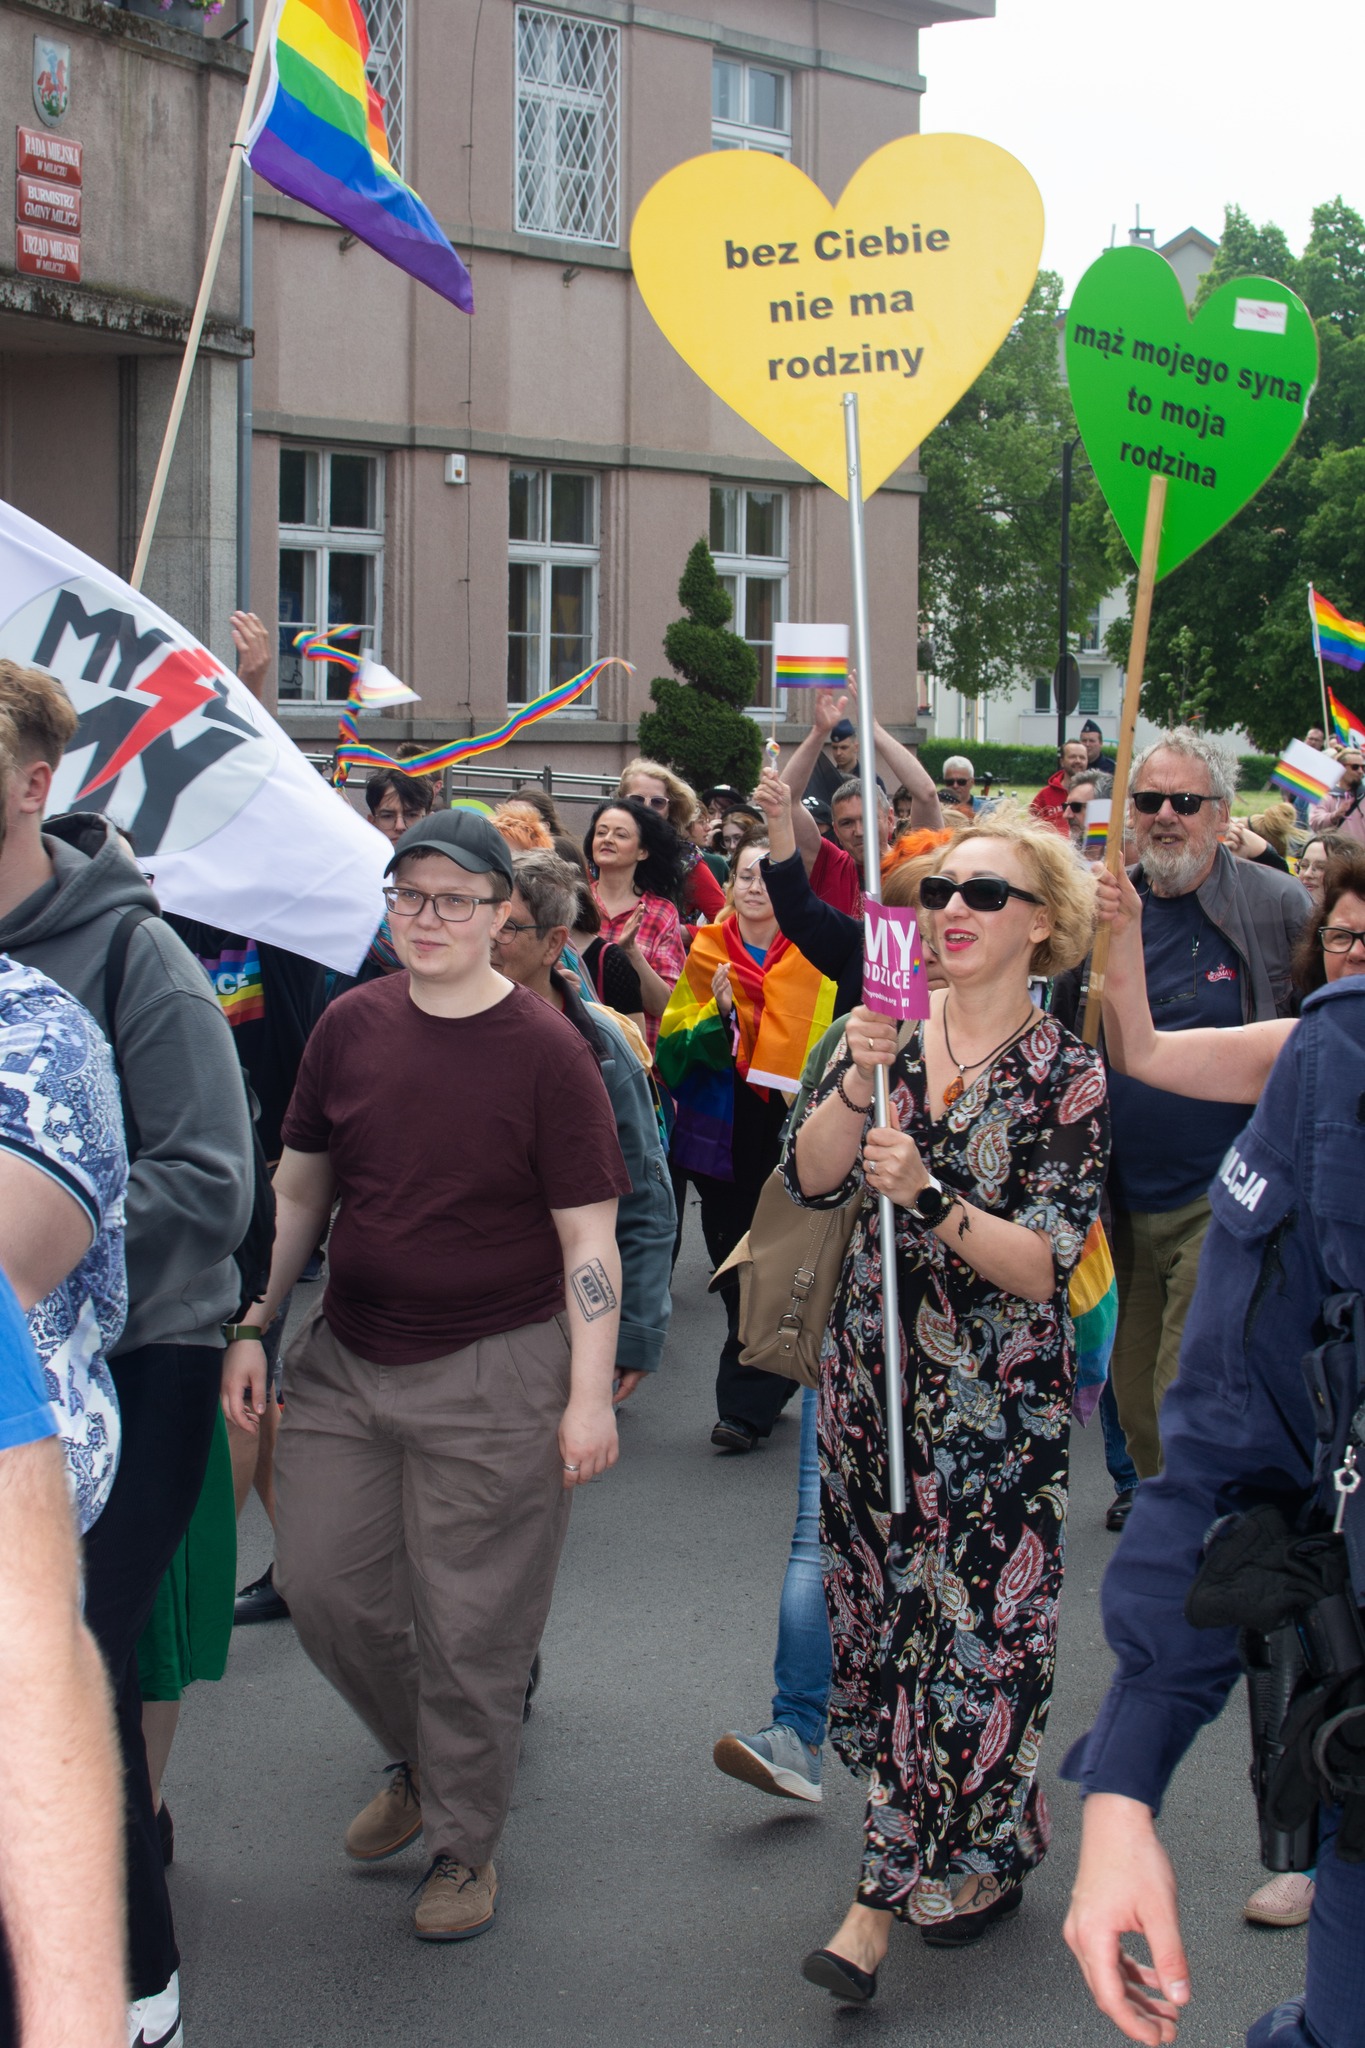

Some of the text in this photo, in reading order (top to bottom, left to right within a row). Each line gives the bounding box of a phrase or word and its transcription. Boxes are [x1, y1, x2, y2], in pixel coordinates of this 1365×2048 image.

[24, 134, 80, 167] RADA MIEJSKA
[37, 160, 68, 177] W MILICZU
[27, 185, 75, 209] BURMISTRZ
[24, 201, 79, 227] GMINY MILICZ
[22, 234, 79, 264] URZĄD MIEJSKI
[725, 223, 950, 269] bez Ciebie
[36, 259, 67, 275] W MILICZU
[770, 290, 913, 322] nie ma
[768, 343, 923, 380] rodziny
[1074, 323, 1302, 404] mąż mojego syna
[1128, 387, 1225, 439] to moja
[1120, 442, 1217, 489] rodzina
[864, 911, 917, 971] MY
